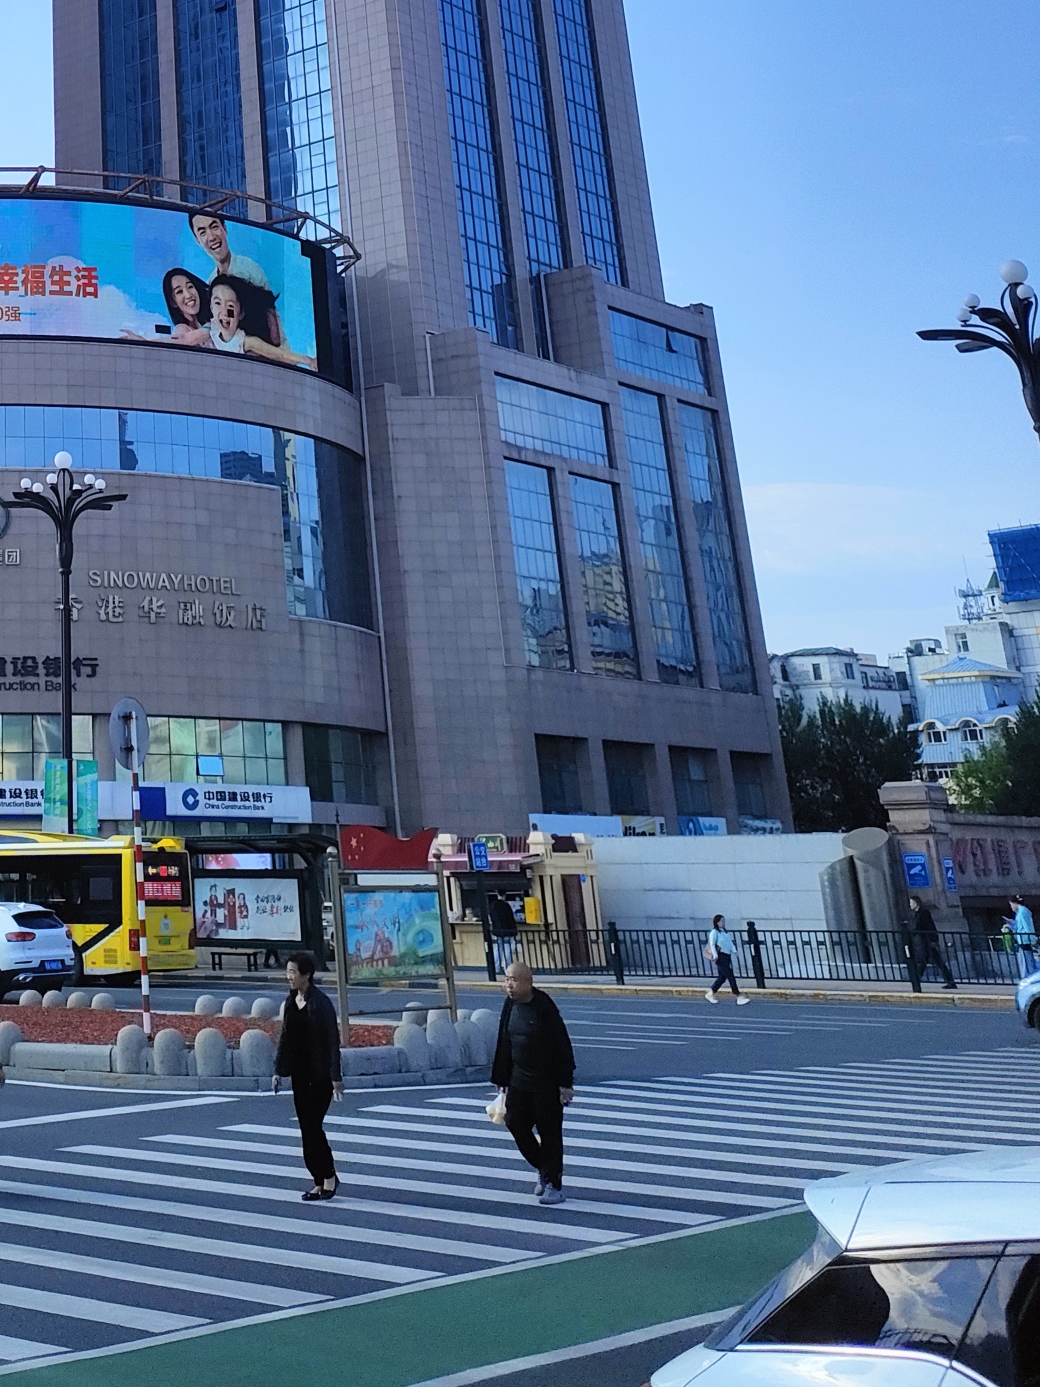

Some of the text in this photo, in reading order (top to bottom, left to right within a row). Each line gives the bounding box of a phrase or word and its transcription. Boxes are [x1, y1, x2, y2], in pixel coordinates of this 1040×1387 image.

[54, 593, 267, 631] 香港华融饭店
[45, 679, 77, 692] Bak
[204, 790, 273, 803] 中国建设银行
[25, 800, 42, 808] Bank
[204, 802, 265, 811] China Construction Bank
